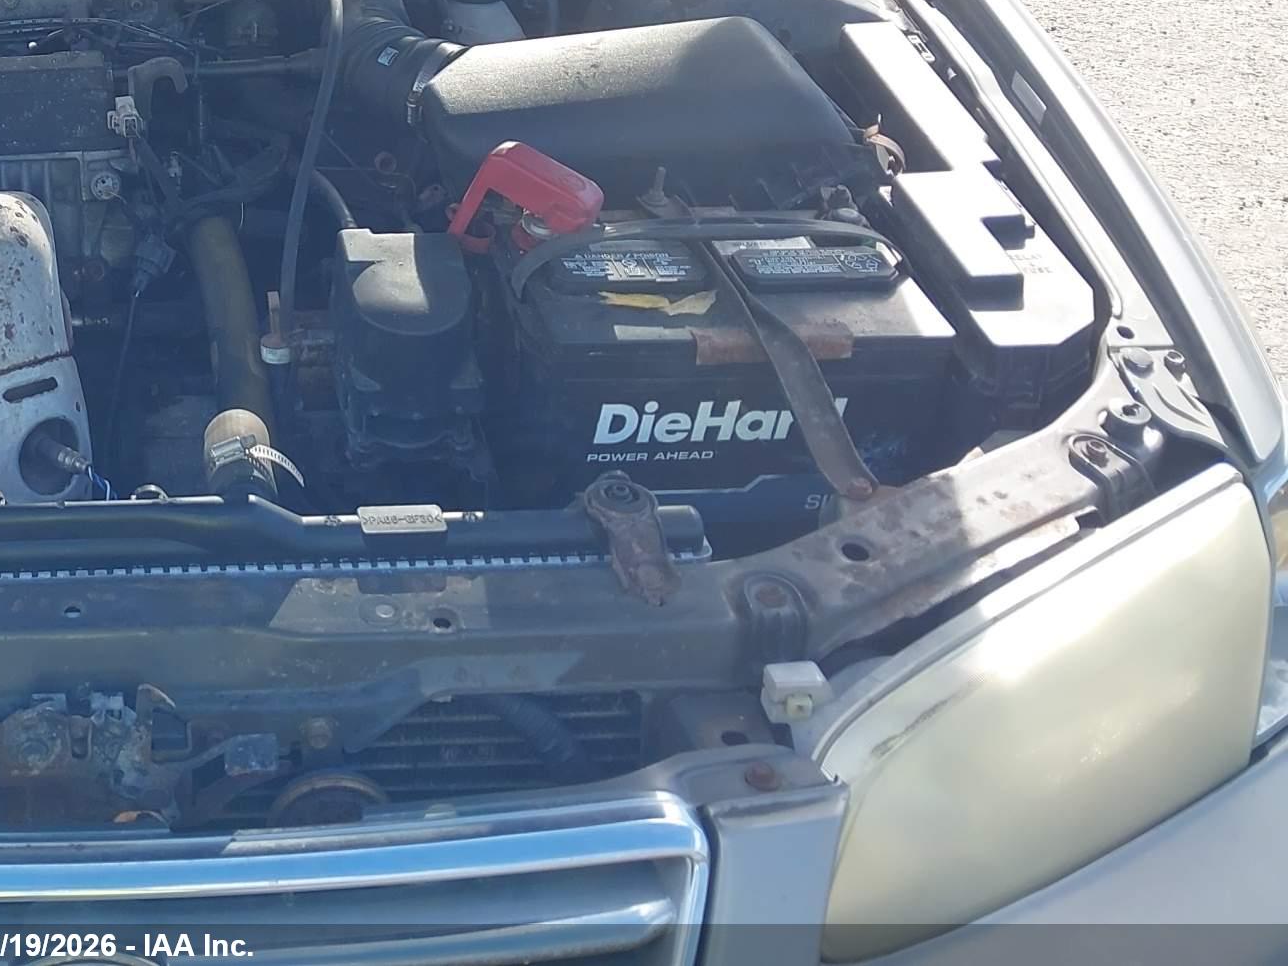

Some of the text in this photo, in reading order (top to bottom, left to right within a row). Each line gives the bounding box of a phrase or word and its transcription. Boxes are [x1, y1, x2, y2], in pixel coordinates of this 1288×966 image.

[593, 397, 848, 445] DieHar
[586, 450, 714, 462] POWER AHEAD
